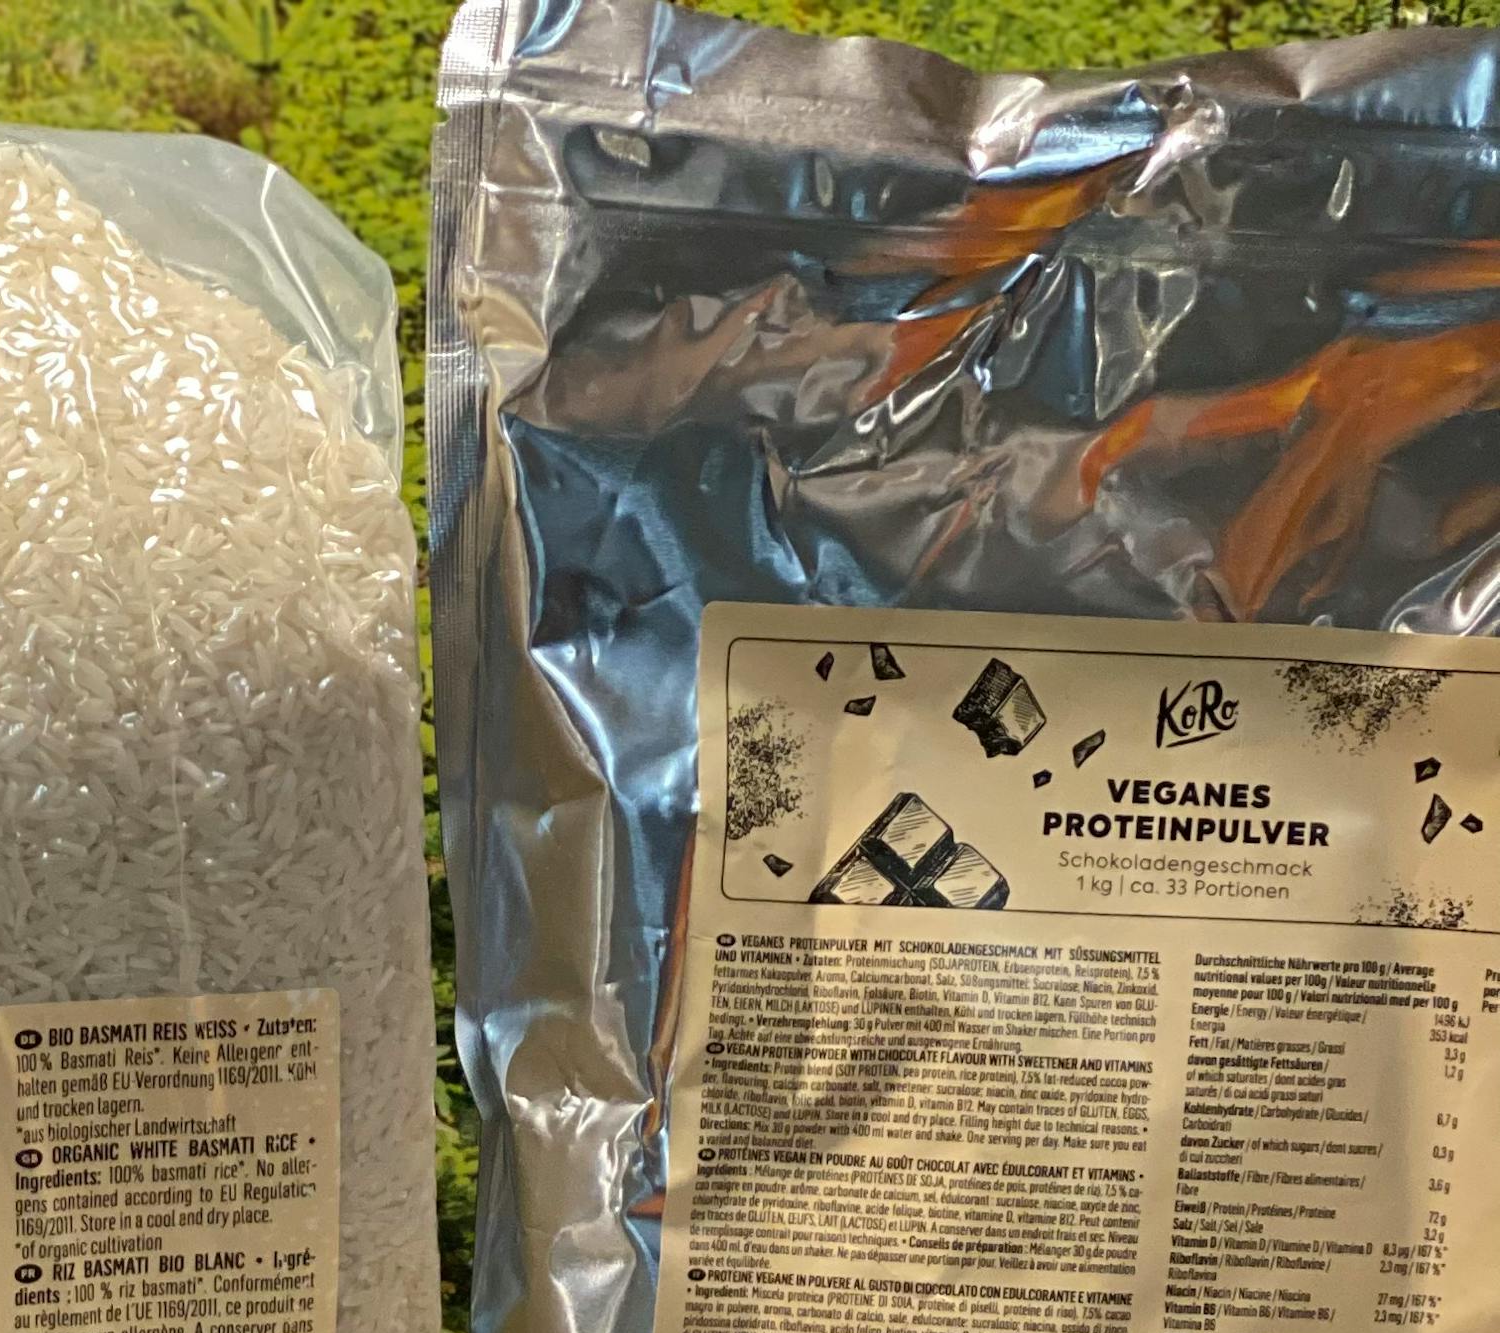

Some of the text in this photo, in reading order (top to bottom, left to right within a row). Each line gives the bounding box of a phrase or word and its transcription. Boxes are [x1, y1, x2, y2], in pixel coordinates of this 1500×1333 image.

[1155, 679, 1239, 749] KoRo
[1106, 778, 1270, 809] VEGANES
[1042, 811, 1329, 847] PROTEINPULVER
[1057, 850, 1313, 877] Schokoladengeschmack
[1076, 875, 1084, 891] 1
[1090, 875, 1113, 897] kg
[1129, 880, 1159, 894] ca.
[1165, 877, 1188, 896] 33
[1193, 879, 1290, 899] Portionen
[715, 949, 792, 965] UND VITAMINEN
[741, 934, 1161, 965] VEGANES PROTEINPULVER MIT SCHOKOLADENGESCHMACK MIT SÜSSUNGSMITTEL
[48, 1018, 237, 1047] BIO BASMATI REIS WEISS
[52, 1142, 119, 1165] ORGANIC
[130, 1139, 178, 1160] WHITE
[188, 1135, 255, 1158] BASMATI
[52, 1251, 245, 1282] RIZ BASMATI BIO BLANC
